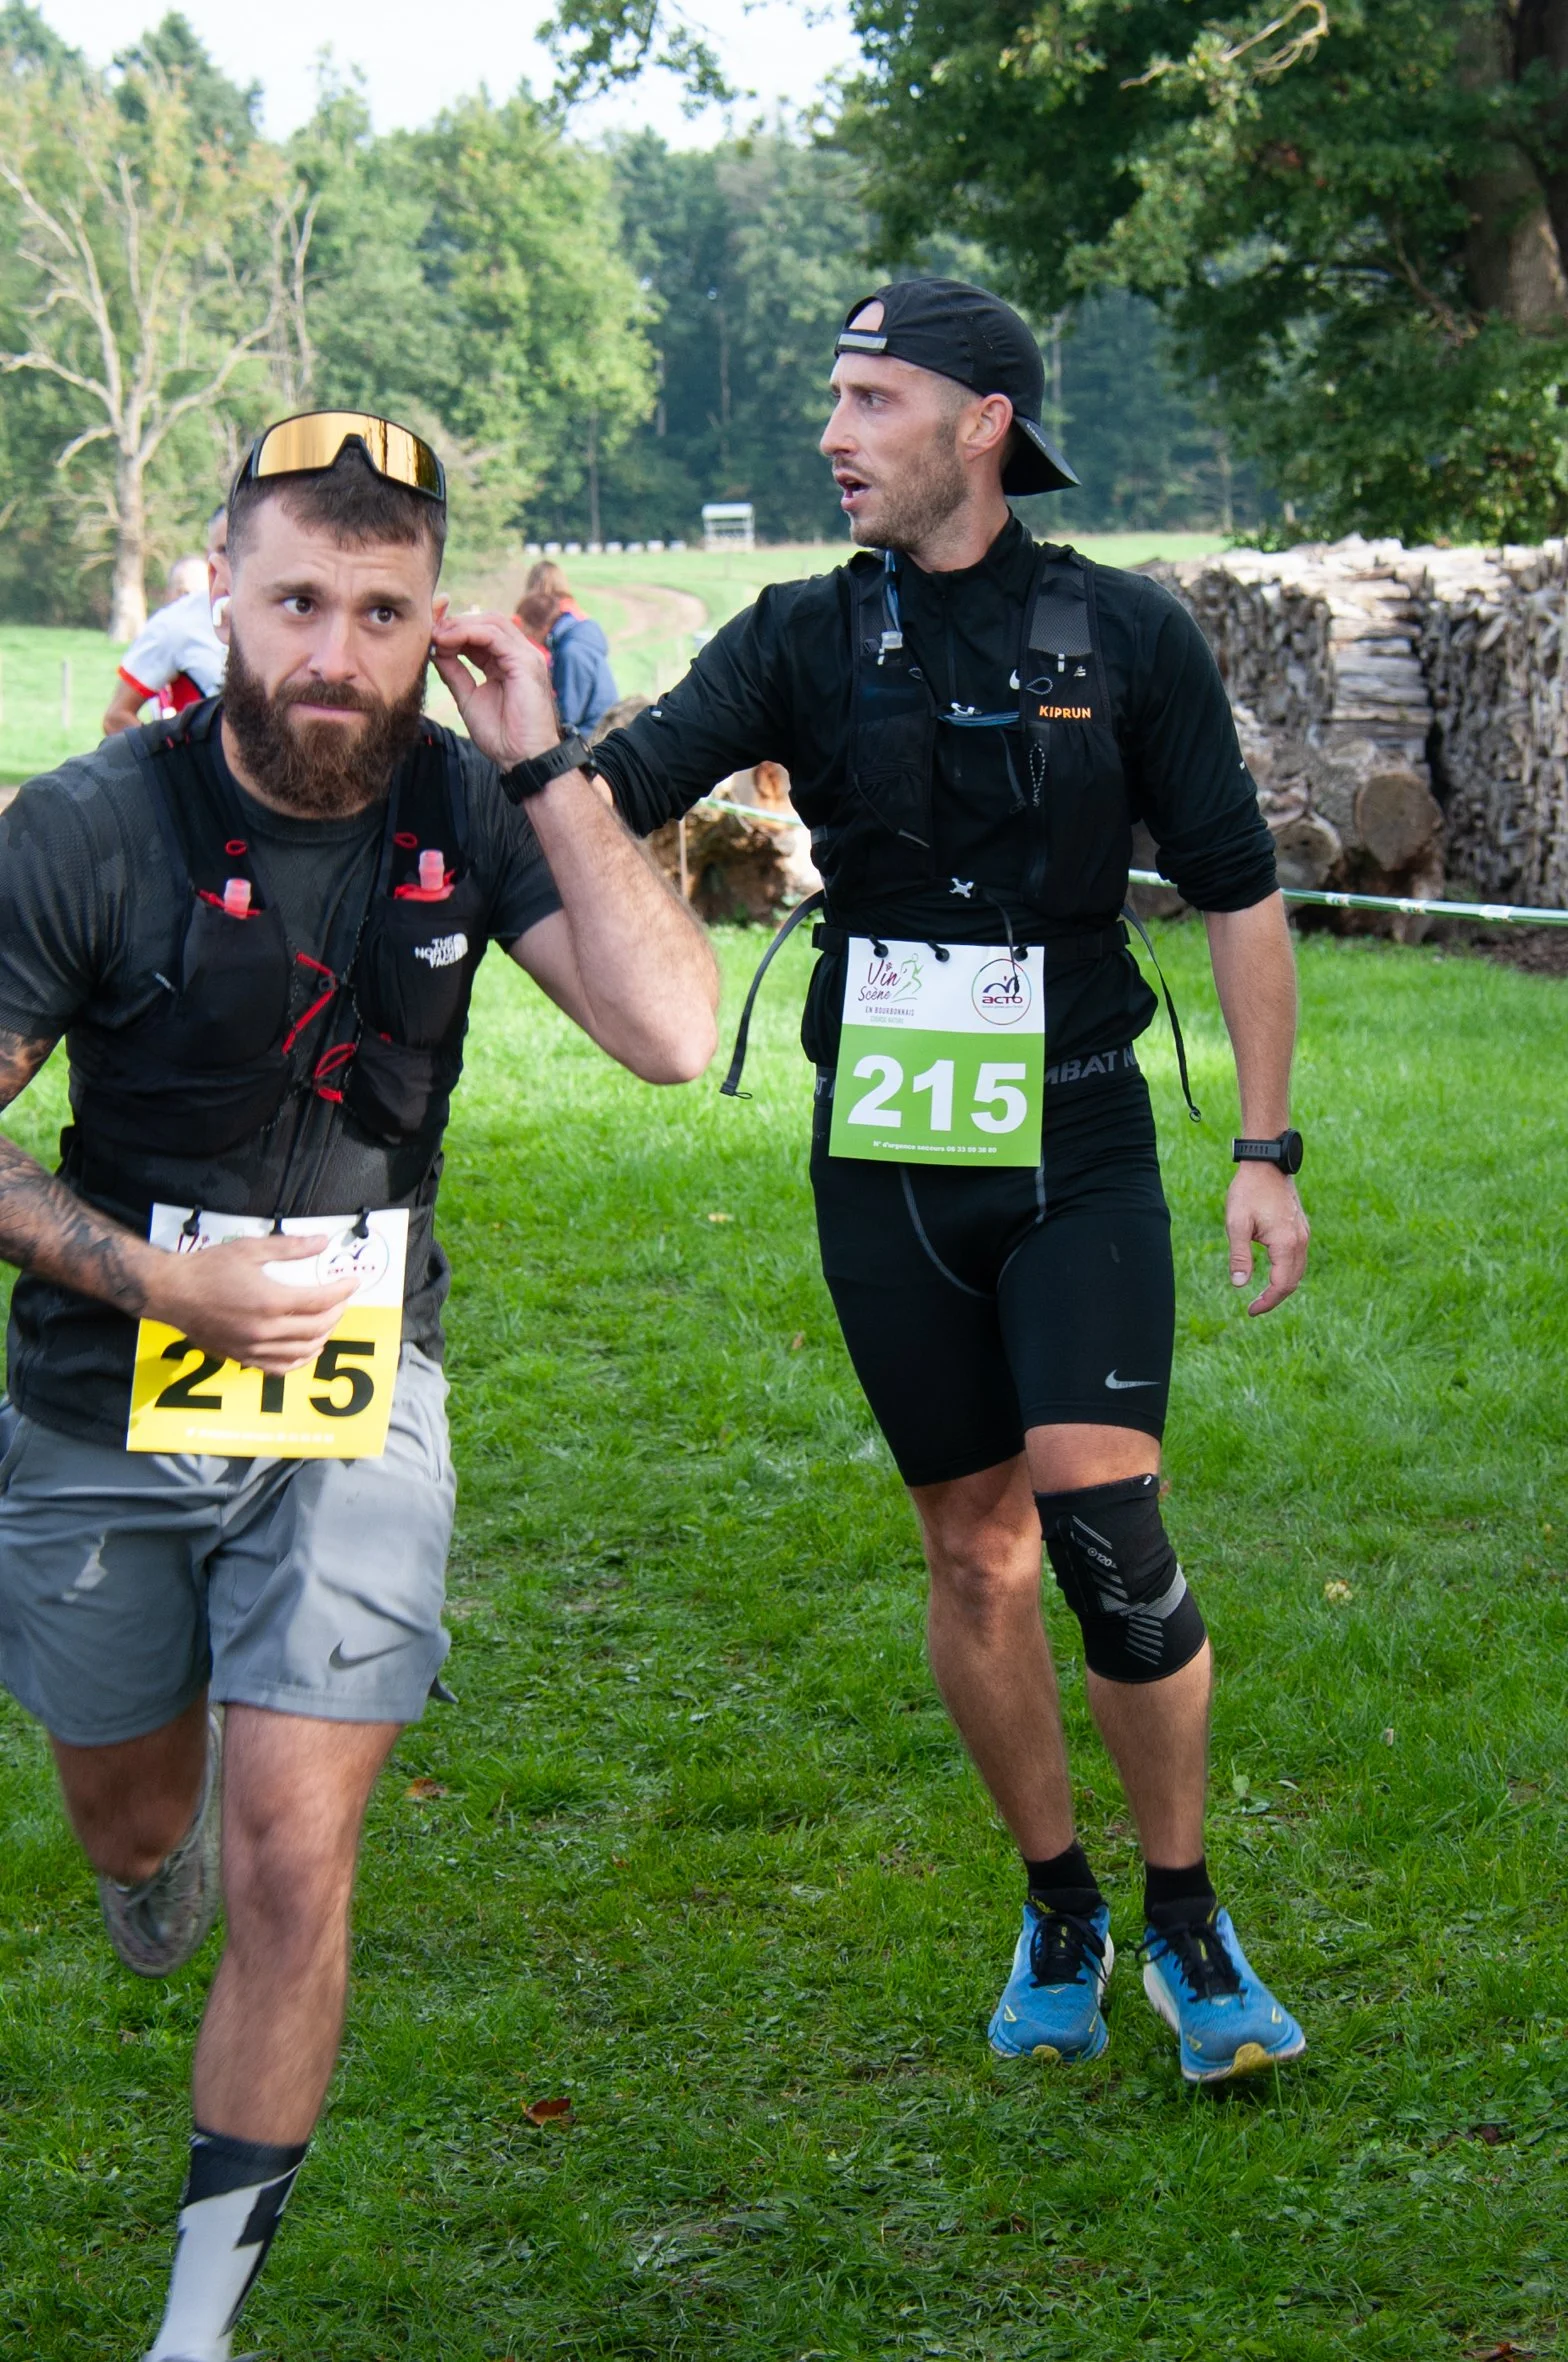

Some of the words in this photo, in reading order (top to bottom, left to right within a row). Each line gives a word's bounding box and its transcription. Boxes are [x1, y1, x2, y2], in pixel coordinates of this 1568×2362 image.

[1039, 705, 1091, 719] KIPRUN
[431, 935, 454, 949] THE
[414, 945, 455, 960] NORTH
[429, 955, 455, 969] FACE
[858, 986, 891, 1001] Scène
[865, 1006, 873, 1014] EN
[874, 1006, 915, 1017] BOURBONNAIS
[847, 1055, 1028, 1134] 215
[154, 1339, 376, 1418] 215
